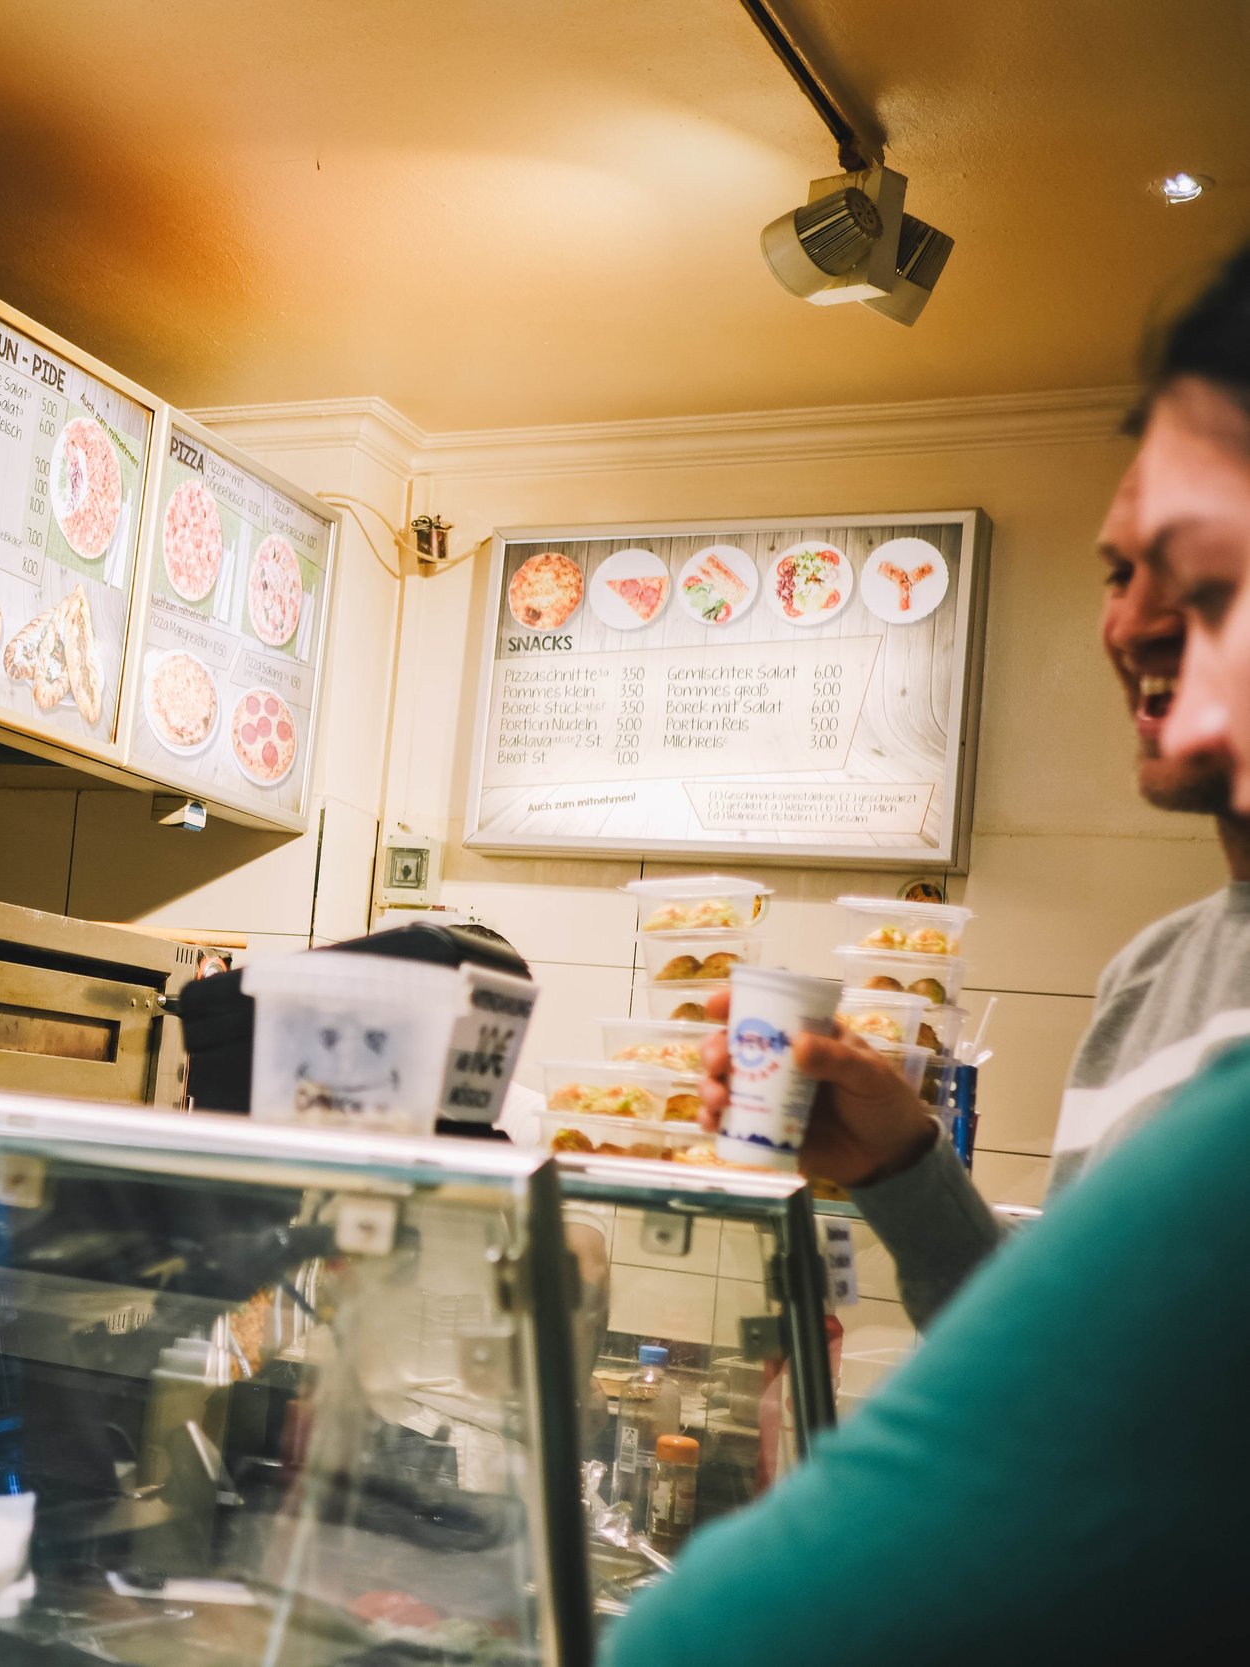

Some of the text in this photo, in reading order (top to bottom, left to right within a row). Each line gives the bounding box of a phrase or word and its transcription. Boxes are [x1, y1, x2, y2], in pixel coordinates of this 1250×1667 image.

[32, 353, 66, 393] PIDE
[41, 397, 58, 418] 5,00
[39, 418, 56, 438] 6,00
[170, 436, 204, 475] PIZZA
[35, 456, 50, 477] 9,00
[34, 477, 48, 497] 1,00
[30, 496, 45, 515] 11,00
[28, 527, 43, 548] 7,00
[508, 635, 573, 652] SNACKS
[504, 667, 645, 683] Pizzaschnitte 3,50
[757, 665, 797, 679] Salat
[814, 664, 843, 680] 6,00
[503, 685, 644, 699] Pommes klein 3,50
[667, 683, 731, 697] Pommes
[813, 682, 841, 698] 5,00
[620, 701, 645, 715] 3,50
[712, 700, 738, 713] mit
[742, 699, 783, 713] Salat
[811, 699, 840, 715] 6,00
[552, 717, 598, 731] Nudeln
[616, 717, 642, 732] 5,00
[722, 717, 750, 731] Reis
[810, 717, 839, 733] 5,00
[499, 734, 552, 748] Baklava
[808, 734, 838, 750] 3,00
[617, 751, 639, 766] 1,00
[527, 792, 636, 813] Auch zum mitnehmen!
